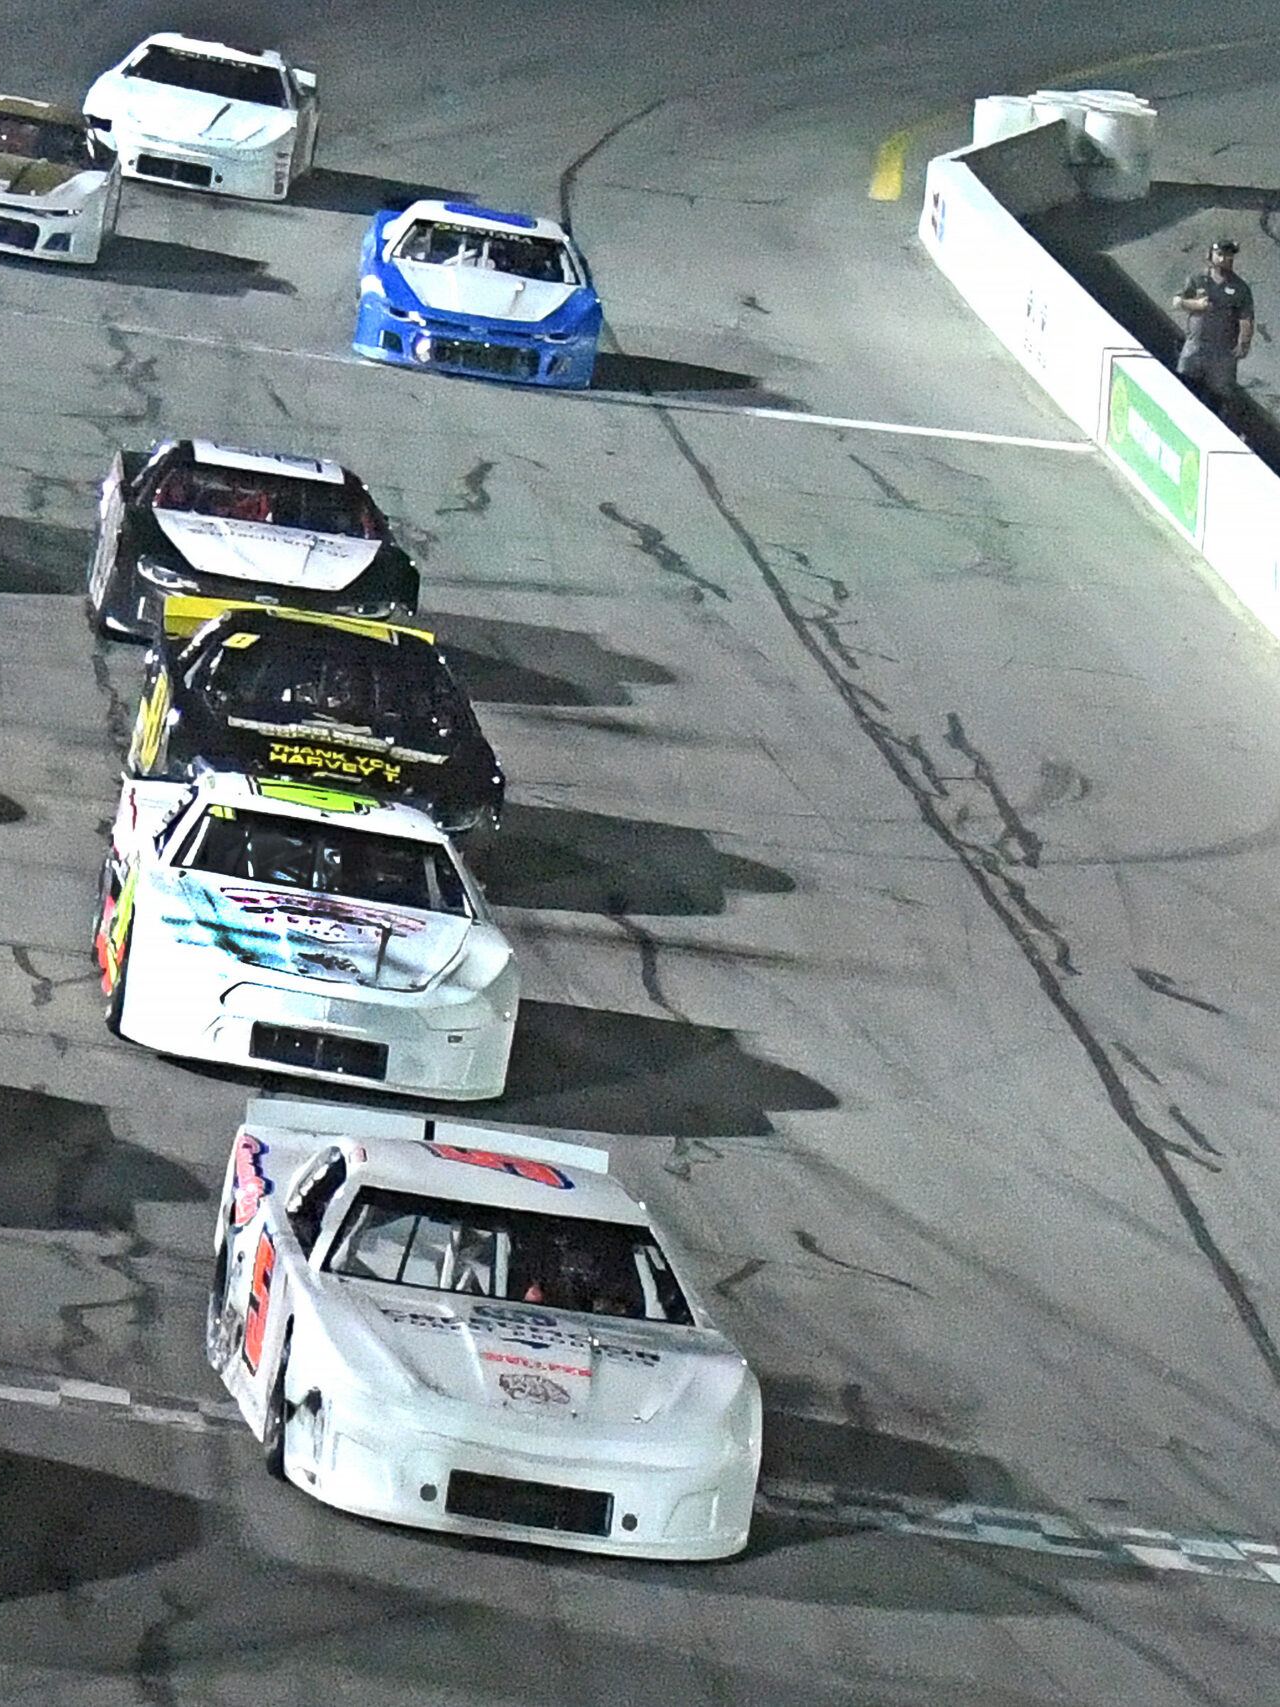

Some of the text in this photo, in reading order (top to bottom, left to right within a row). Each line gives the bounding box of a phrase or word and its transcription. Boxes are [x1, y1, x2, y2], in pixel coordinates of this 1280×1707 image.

[270, 743, 347, 761] THANK
[355, 755, 401, 774] YOU
[270, 752, 375, 776] HARVEY
